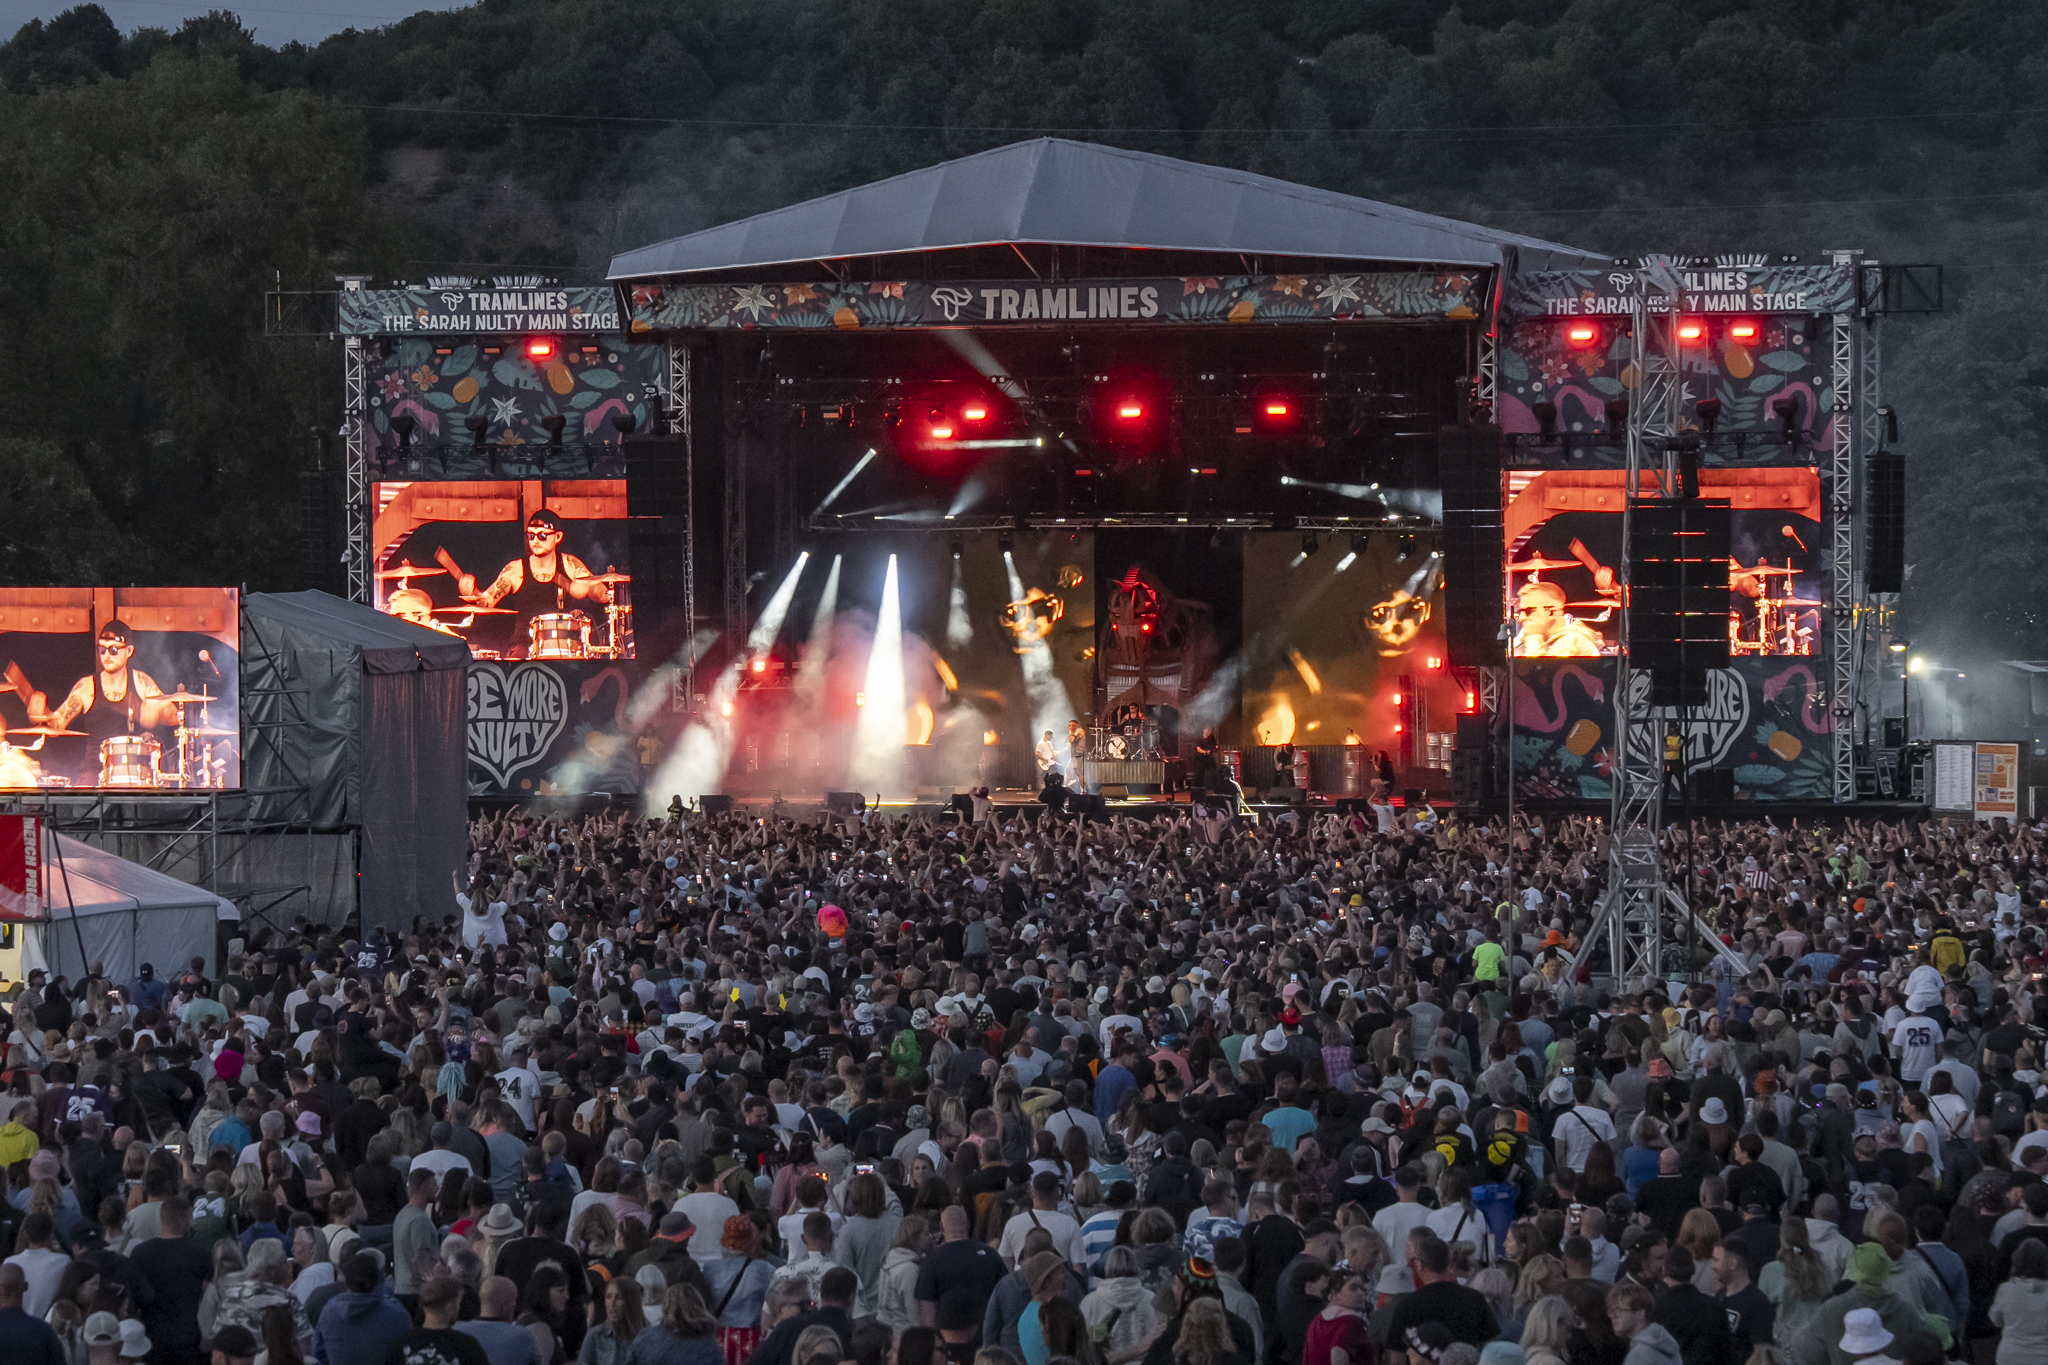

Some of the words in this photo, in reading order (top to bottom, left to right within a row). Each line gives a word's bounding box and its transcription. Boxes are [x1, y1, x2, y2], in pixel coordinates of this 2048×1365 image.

[1681, 272, 1747, 291] LINES
[468, 292, 568, 311] TRAMLINES
[980, 286, 1159, 319] TRAMLINES
[1545, 298, 1578, 315] THE
[1647, 295, 1699, 313] NUY
[1704, 294, 1747, 311] MAIN
[1753, 292, 1807, 311] STAGE
[383, 314, 413, 332] THE
[419, 314, 471, 331] SARAH
[475, 314, 525, 331] NULTY
[528, 313, 567, 330] MAIN
[572, 312, 620, 330] STAGE
[508, 669, 561, 720] MORE
[22, 816, 37, 866] MERCH
[357, 951, 378, 968] 25
[548, 944, 564, 958] 24
[1906, 1027, 1930, 1047] 25
[498, 1076, 522, 1100] 24
[66, 1096, 95, 1121] 25
[192, 1197, 225, 1219] 24
